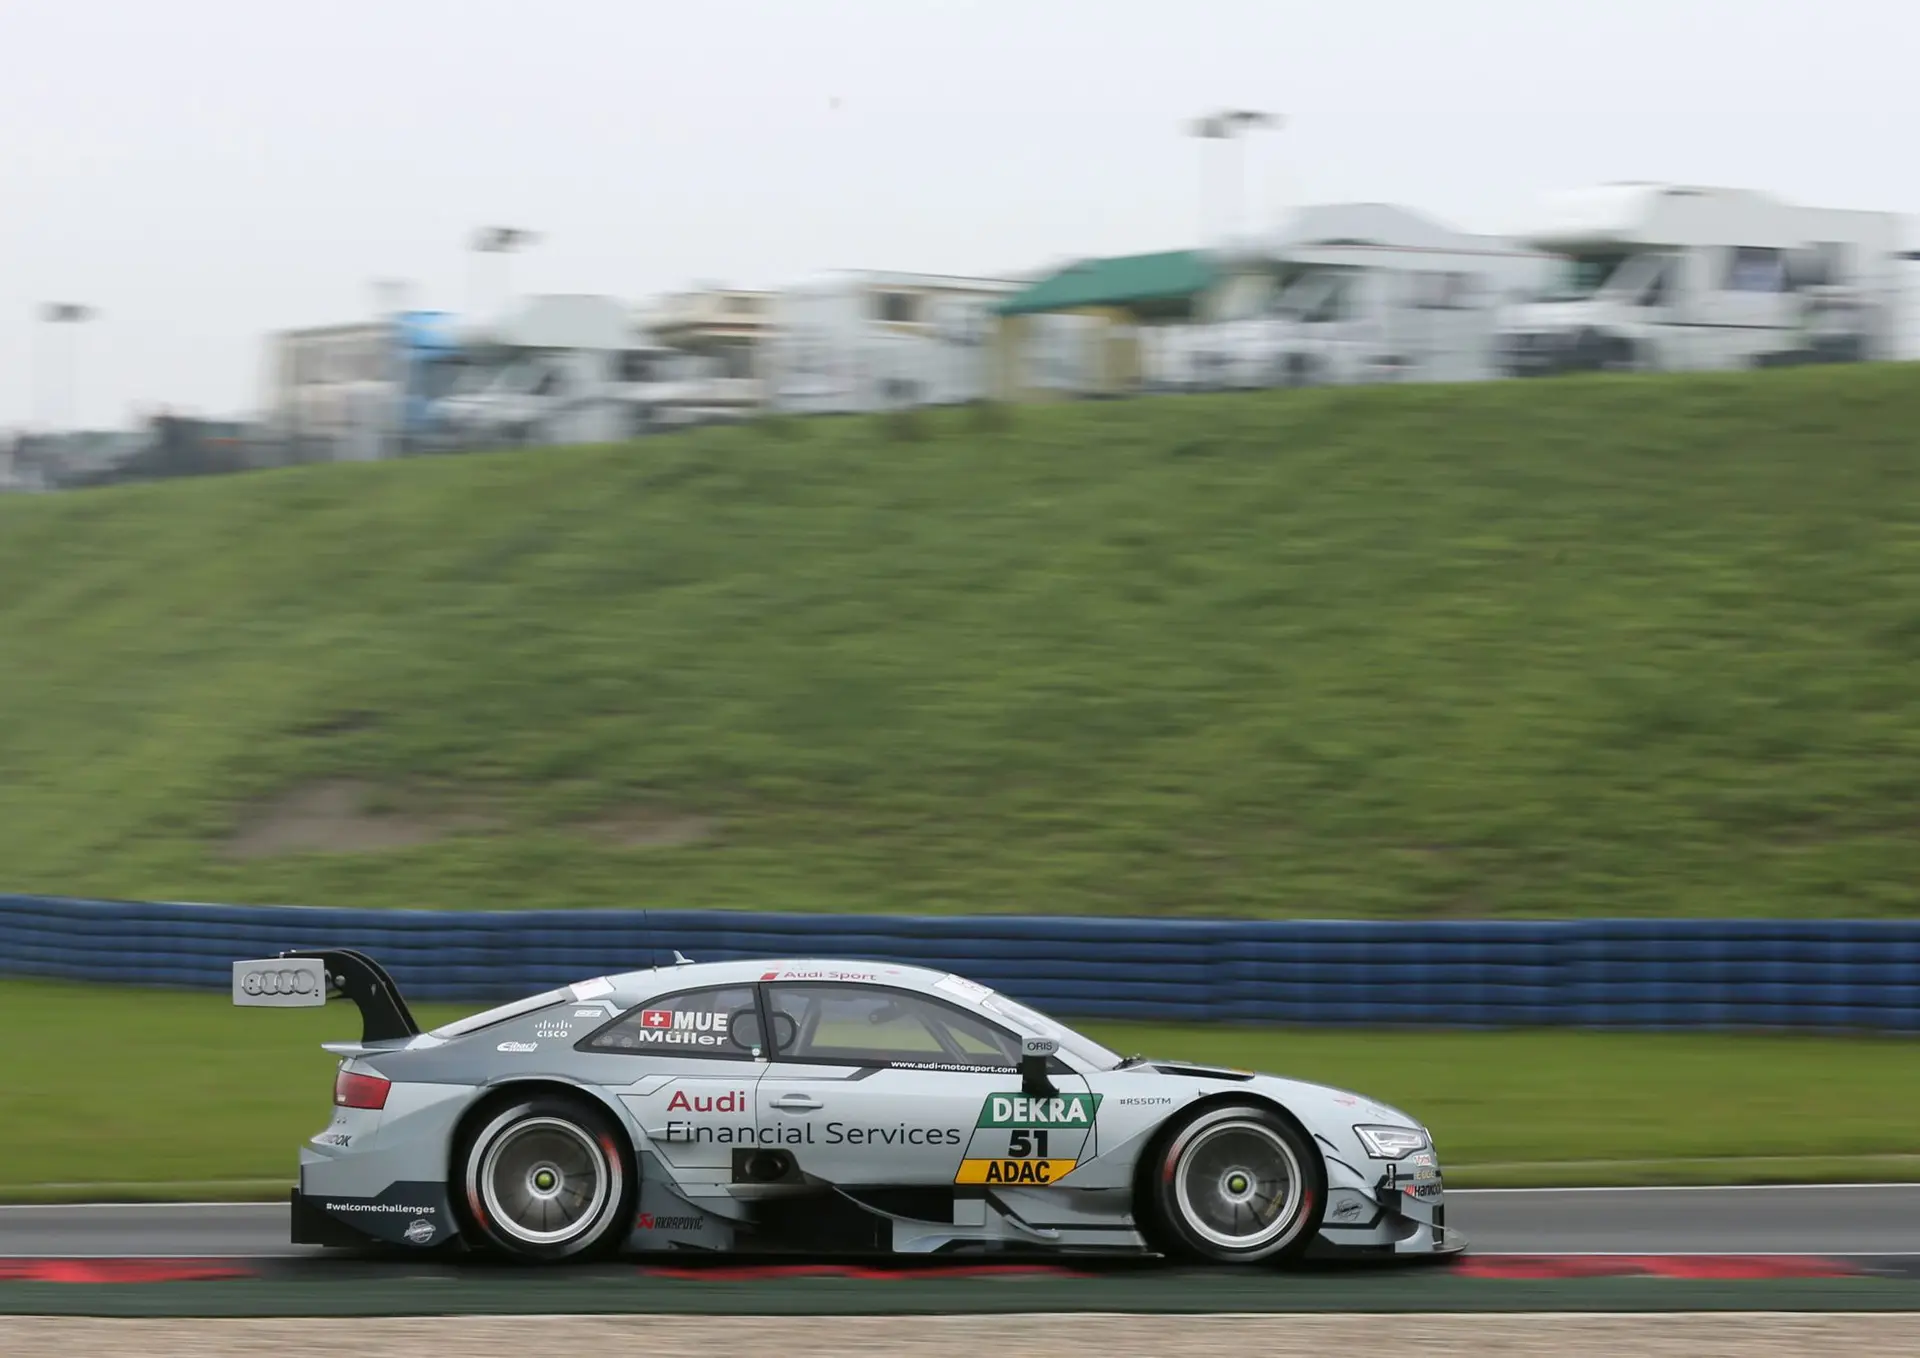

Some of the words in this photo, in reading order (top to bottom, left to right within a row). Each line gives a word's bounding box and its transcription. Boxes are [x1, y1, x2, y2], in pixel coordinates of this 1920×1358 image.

[828, 972, 877, 980] Sport
[674, 1011, 728, 1032] MUE
[639, 1030, 727, 1046] Müller
[1027, 1042, 1053, 1051] ORIS
[891, 1060, 1017, 1073] www.audi-motorsport.com
[666, 1090, 746, 1112] Audi
[992, 1098, 1087, 1122] DEKRA
[665, 1121, 815, 1144] Financial
[825, 1122, 961, 1145] Services
[1008, 1130, 1048, 1158] 51
[985, 1161, 1050, 1183] ADAC
[326, 1203, 435, 1215] #welcomechallenges
